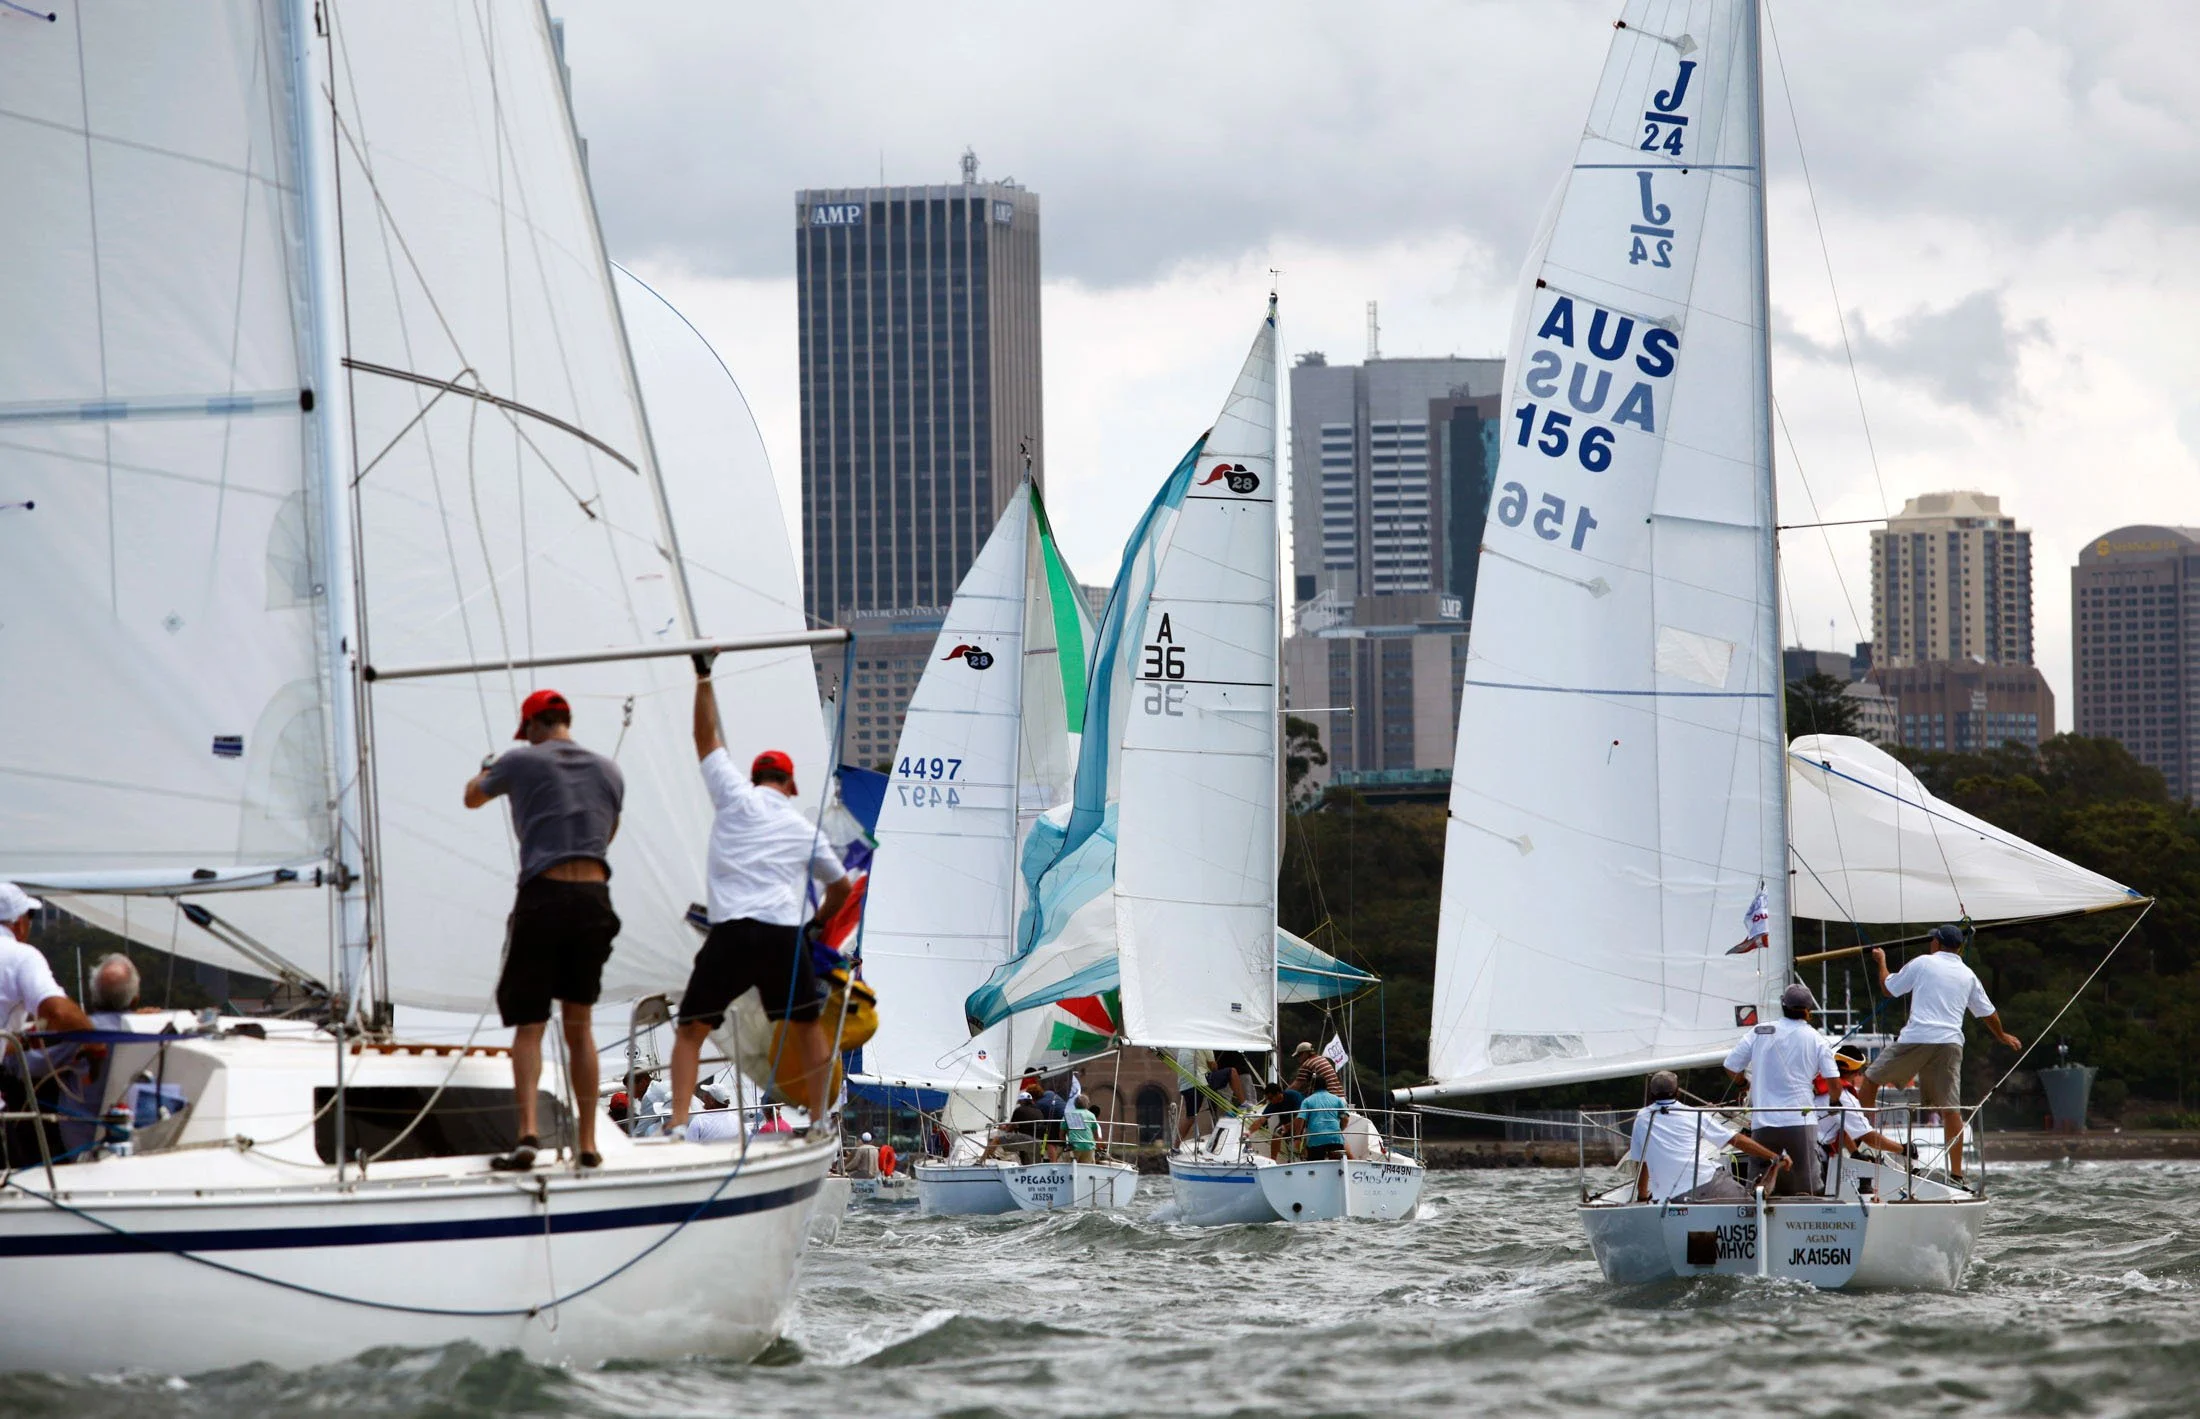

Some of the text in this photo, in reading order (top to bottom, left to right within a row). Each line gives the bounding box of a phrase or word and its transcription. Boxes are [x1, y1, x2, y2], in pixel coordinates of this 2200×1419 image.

[1653, 60, 1698, 113] J
[1640, 122, 1684, 156] 24
[813, 205, 861, 224] AMP
[995, 203, 1013, 223] AMP
[1537, 295, 1680, 378] AUS
[1515, 402, 1616, 473] 156
[1231, 475, 1254, 491] 28
[855, 605, 947, 619] INTERCONTINENT
[1440, 598, 1462, 619] AMP
[1156, 612, 1173, 644] A
[969, 655, 990, 667] 28
[1144, 645, 1186, 679] 36
[898, 756, 963, 781] 4497
[1020, 1175, 1065, 1185] PEGASUS
[1715, 1224, 1758, 1243] AUS15
[1786, 1220, 1857, 1231] WATERBORNE
[1806, 1233, 1837, 1244] AGAIN
[1714, 1242, 1756, 1260] MHYC
[1788, 1248, 1851, 1266] JKA156N
